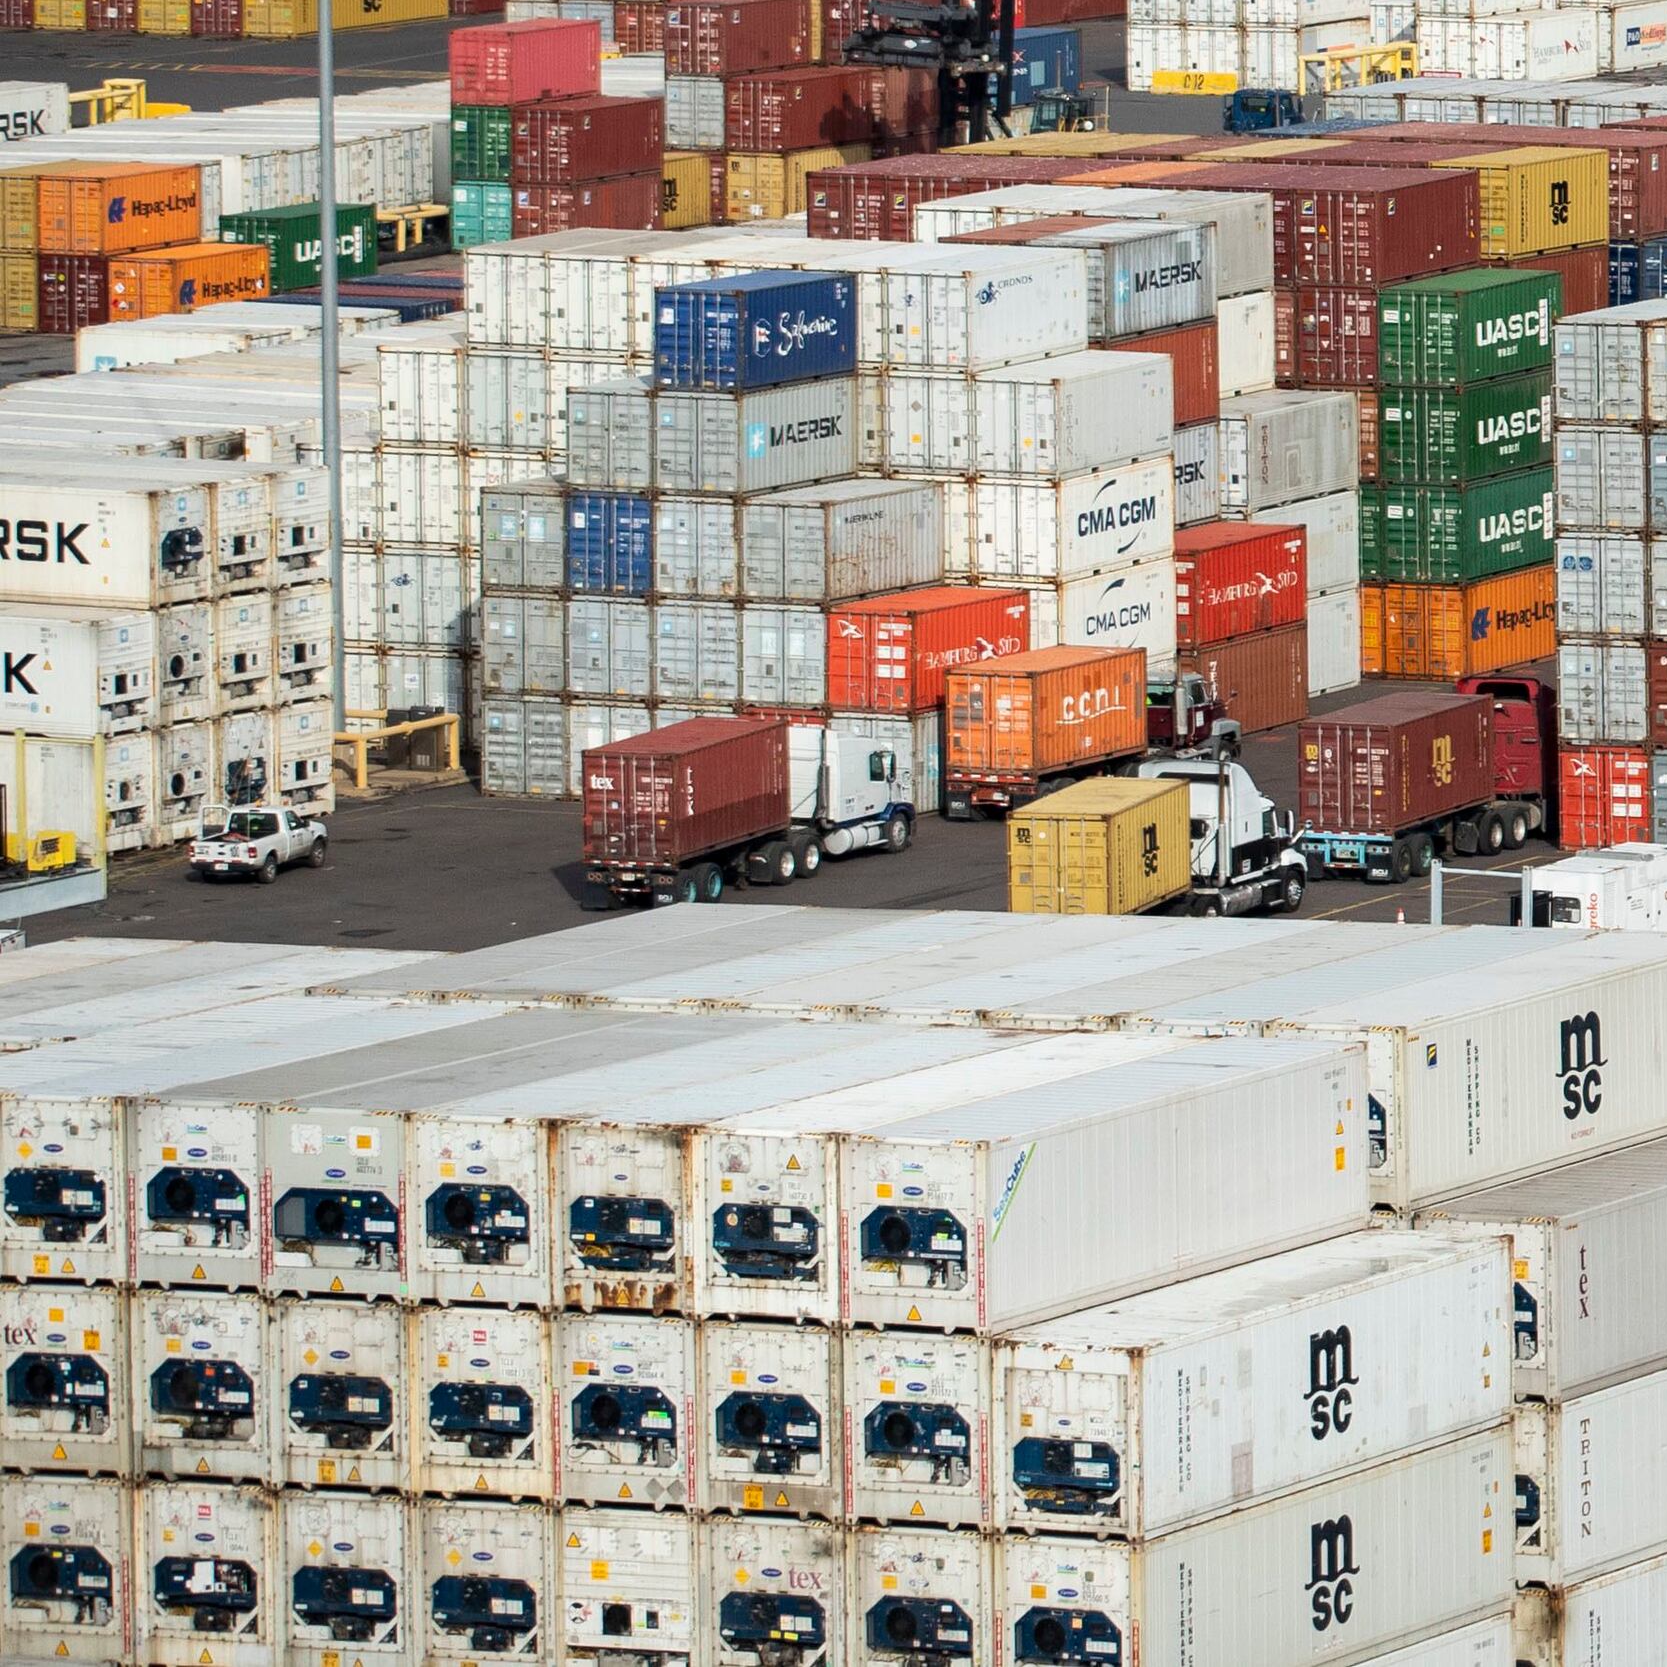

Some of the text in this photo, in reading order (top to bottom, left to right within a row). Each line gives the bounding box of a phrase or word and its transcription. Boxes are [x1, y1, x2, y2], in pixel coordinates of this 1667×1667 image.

[132, 195, 196, 219] Hapag-Lloyd
[998, 276, 1033, 290] CRONOS
[1134, 261, 1201, 293] MAERSK
[1477, 312, 1539, 347] UASC
[770, 415, 842, 448] MAERSK
[1479, 409, 1541, 446] UASC
[1260, 425, 1269, 485] TRITON
[1077, 496, 1156, 536] CMA CGM
[1479, 507, 1541, 542] UASC
[1207, 580, 1259, 606] HAMBURG
[1086, 602, 1151, 636] CMA CGM
[590, 774, 613, 790] tex
[1465, 1038, 1474, 1156] MEDITERRANEAN
[1473, 1046, 1481, 1145] SHIPPING CO
[1578, 1244, 1590, 1320] tex
[3, 1324, 37, 1346] tex
[1177, 1368, 1186, 1493] MEDITERRANEAN
[1186, 1464, 1192, 1482] CO
[1579, 1419, 1593, 1537] TRITON
[788, 1565, 825, 1593] tex
[1186, 1569, 1194, 1651] SHIPPING
